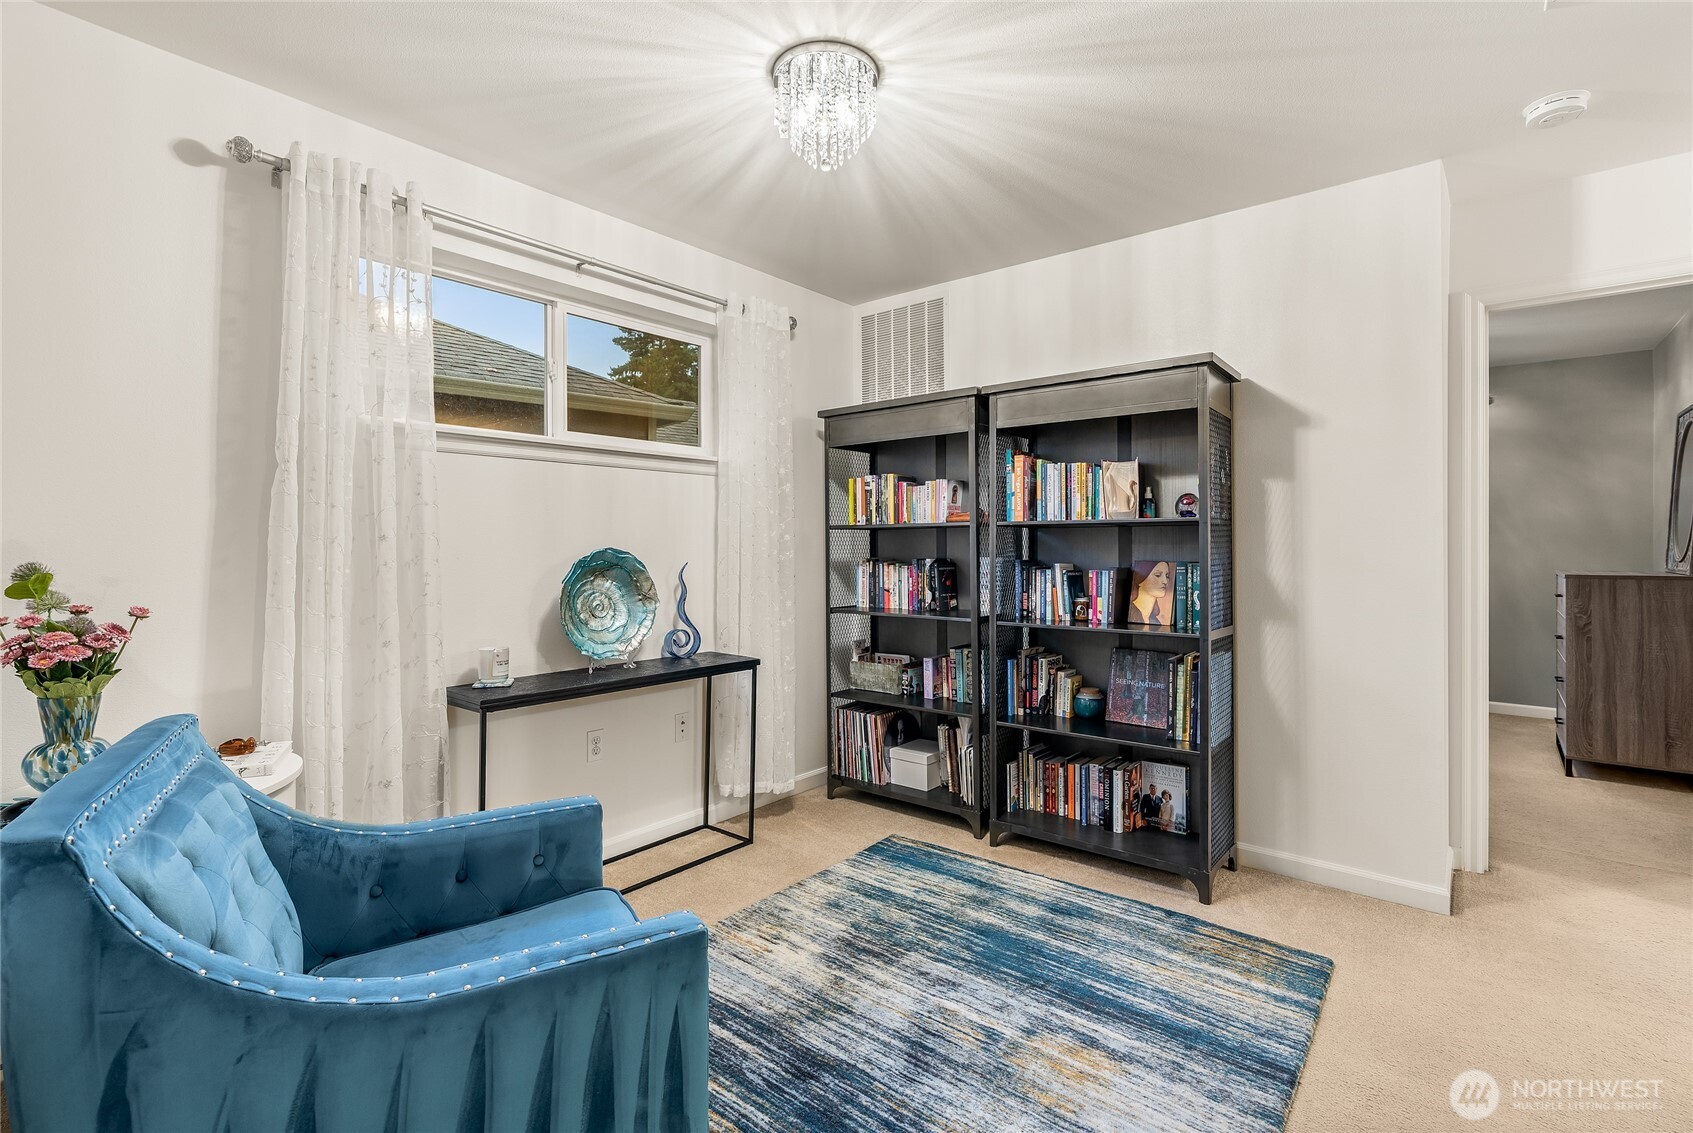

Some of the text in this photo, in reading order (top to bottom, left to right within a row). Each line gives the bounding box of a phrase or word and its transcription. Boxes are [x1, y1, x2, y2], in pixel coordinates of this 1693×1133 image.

[1115, 677, 1165, 690] SEEING NATURE
[1145, 767, 1183, 778] KENNEDY
